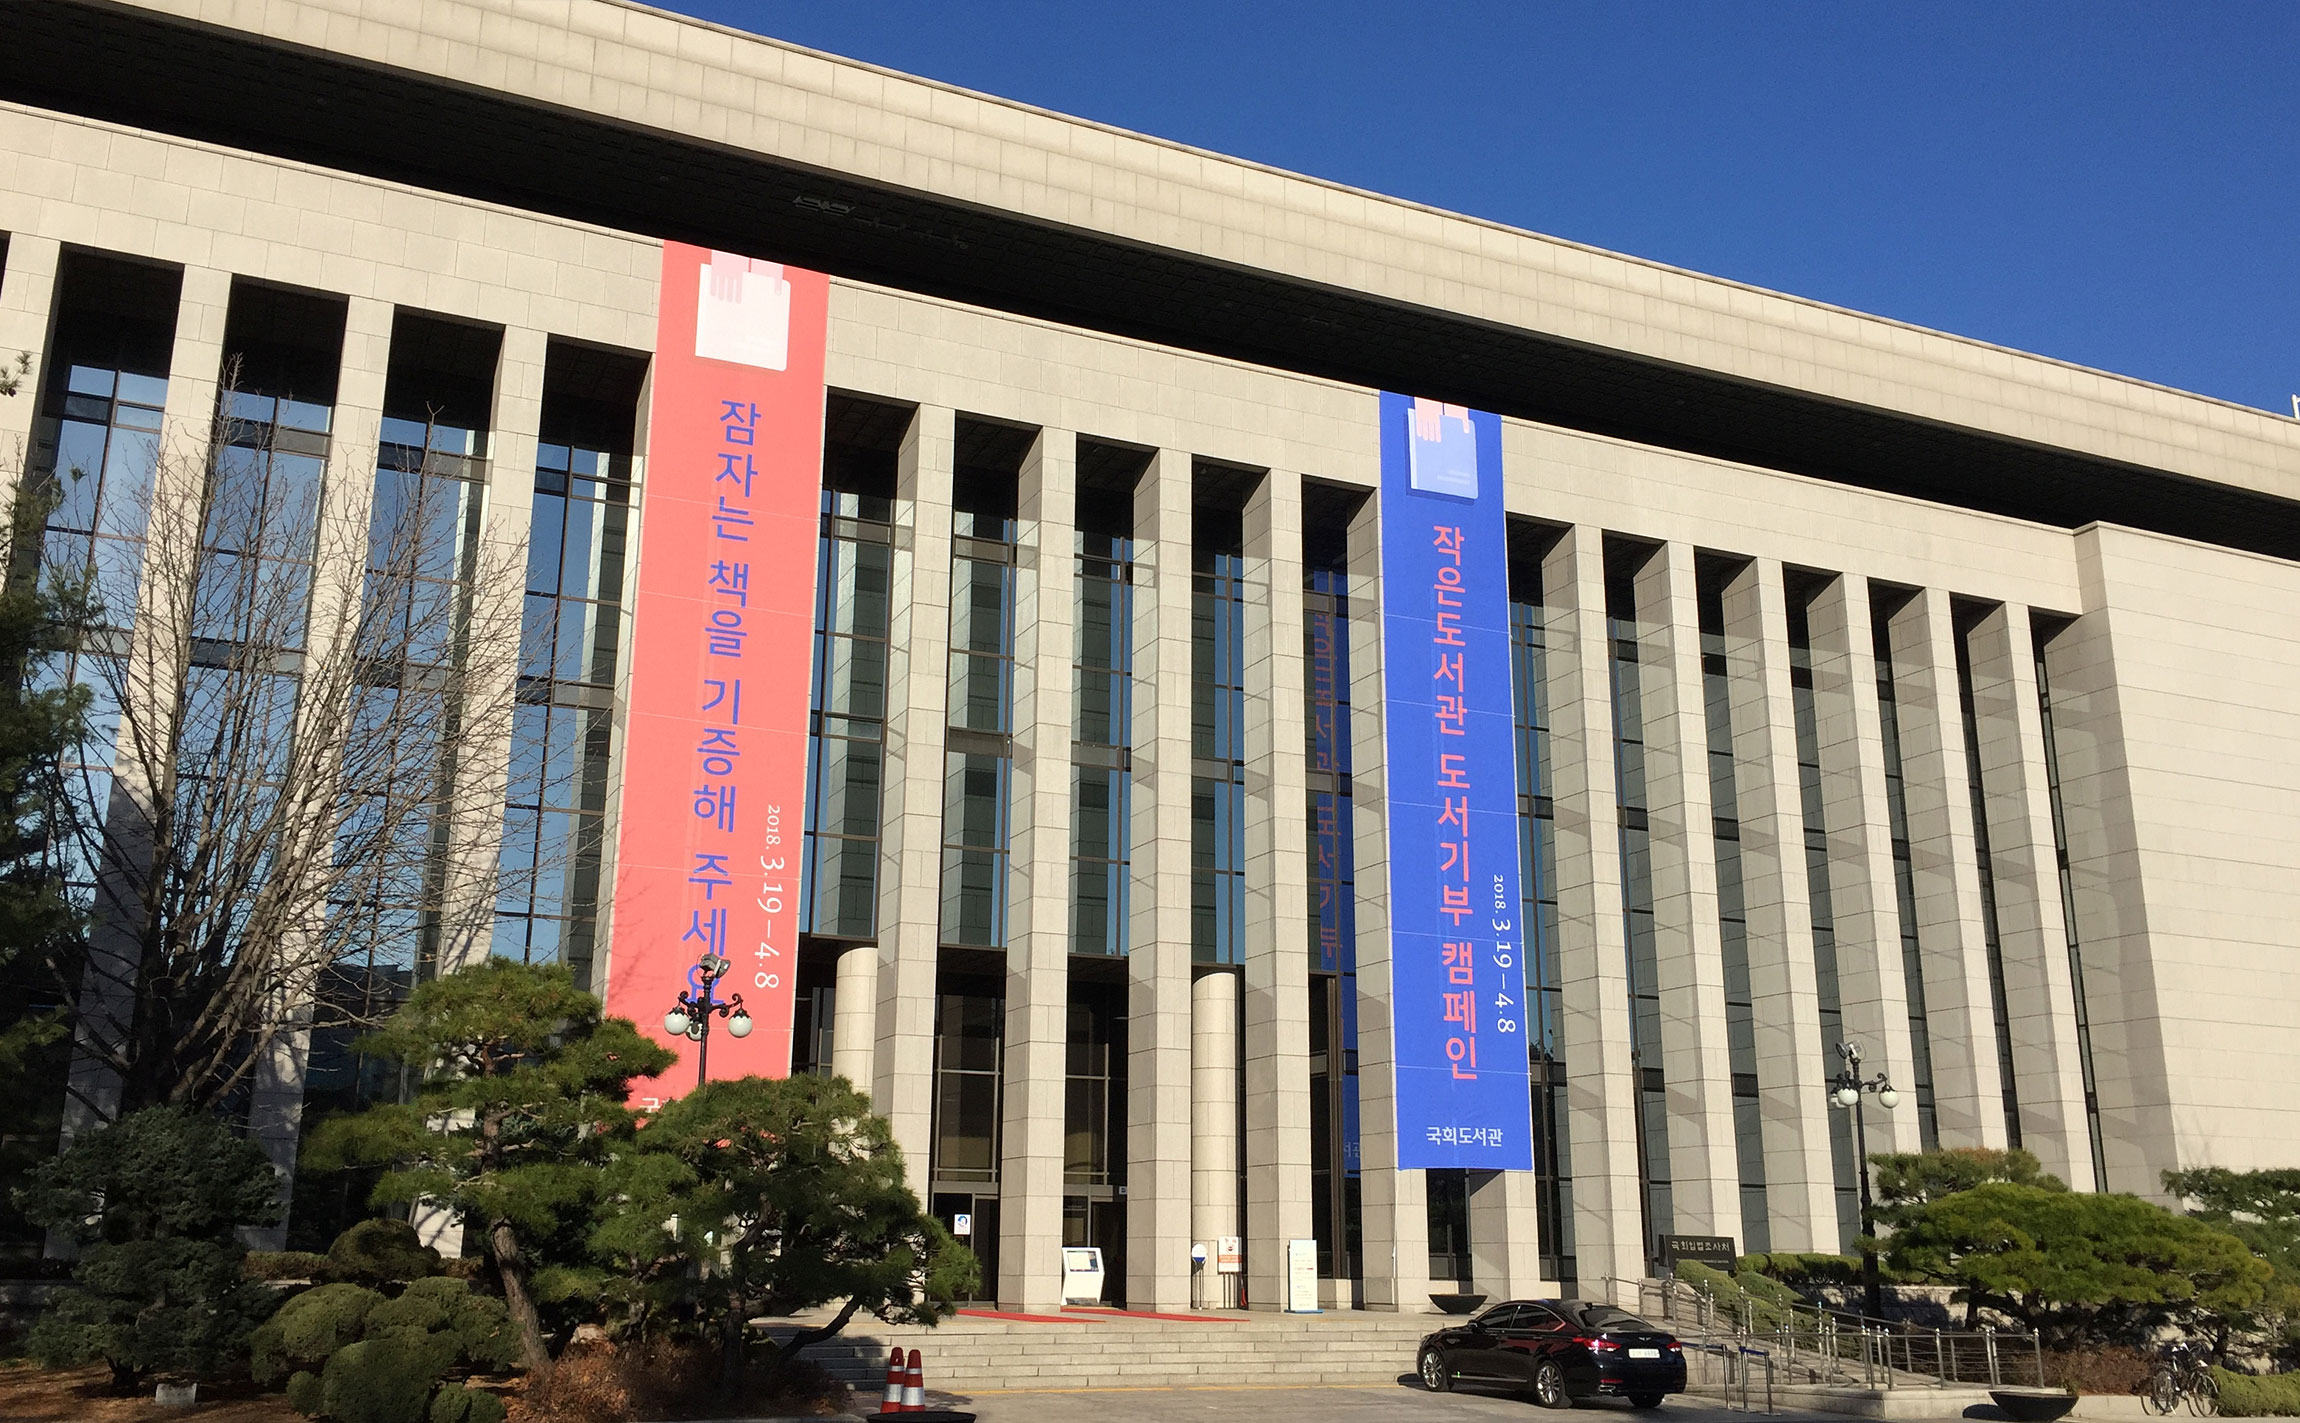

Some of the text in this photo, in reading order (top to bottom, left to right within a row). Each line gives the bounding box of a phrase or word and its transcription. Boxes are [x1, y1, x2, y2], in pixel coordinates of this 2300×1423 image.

[682, 400, 761, 1005] 잠자는 책을 기증해 주세요
[1433, 525, 1477, 1080] 작은도서관 도서기부 캠페인
[1426, 1126, 1503, 1147] 국회도서관
[1671, 1240, 1730, 1252] 국회입법조사처
